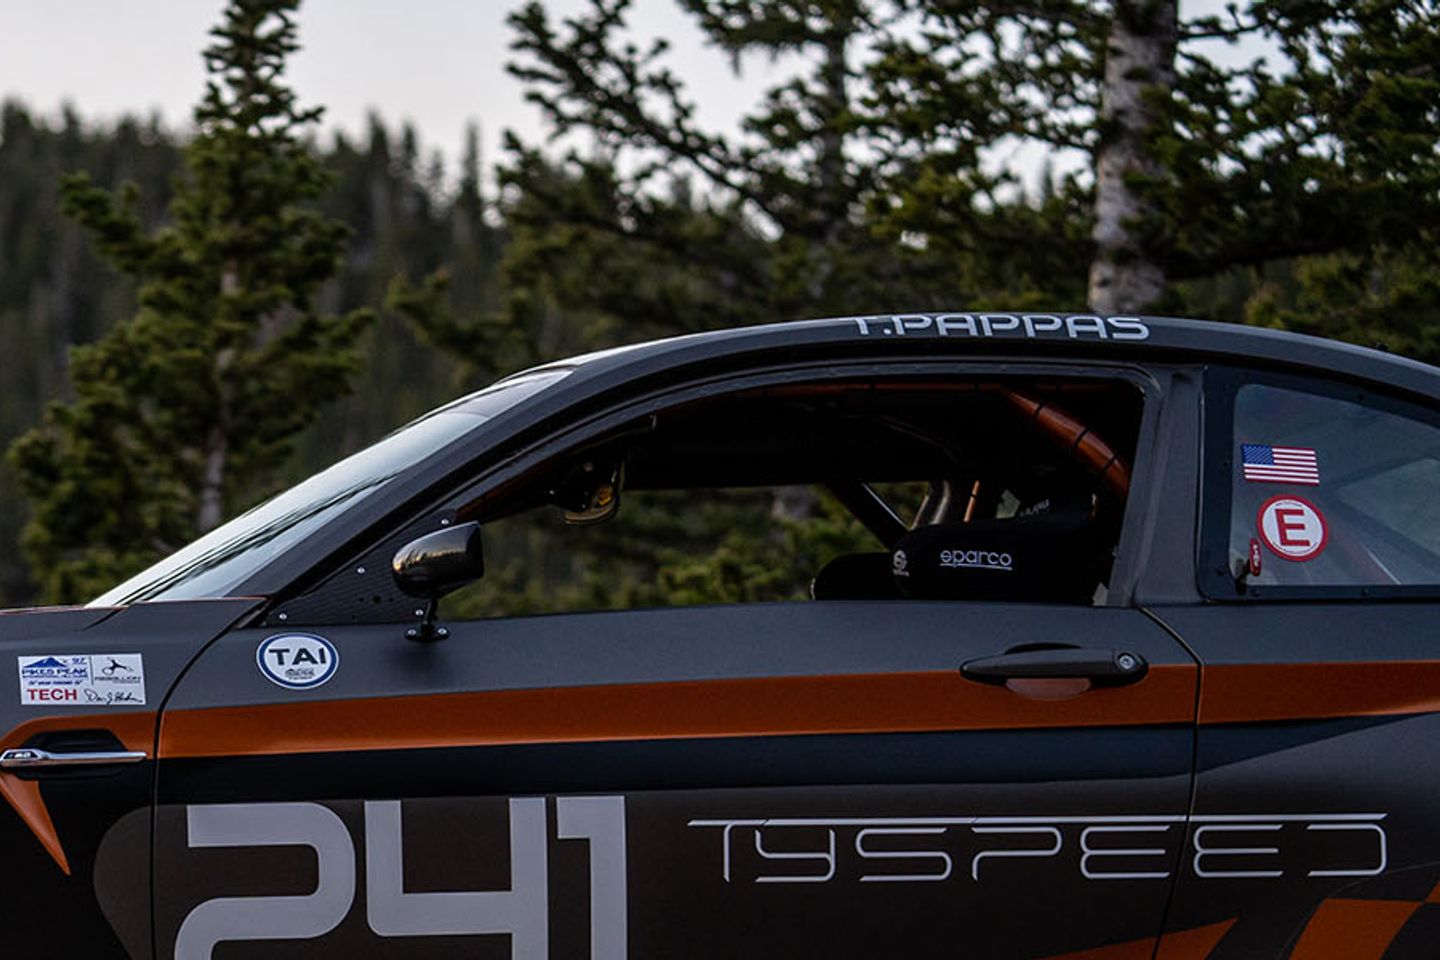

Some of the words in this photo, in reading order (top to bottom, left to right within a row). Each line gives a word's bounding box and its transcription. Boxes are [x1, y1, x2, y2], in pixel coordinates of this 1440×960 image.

[854, 314, 1151, 341] T.PAPPAS
[1275, 508, 1312, 547] E
[940, 549, 1013, 570] sparco
[268, 647, 327, 667] TAI
[26, 687, 78, 701] TECH
